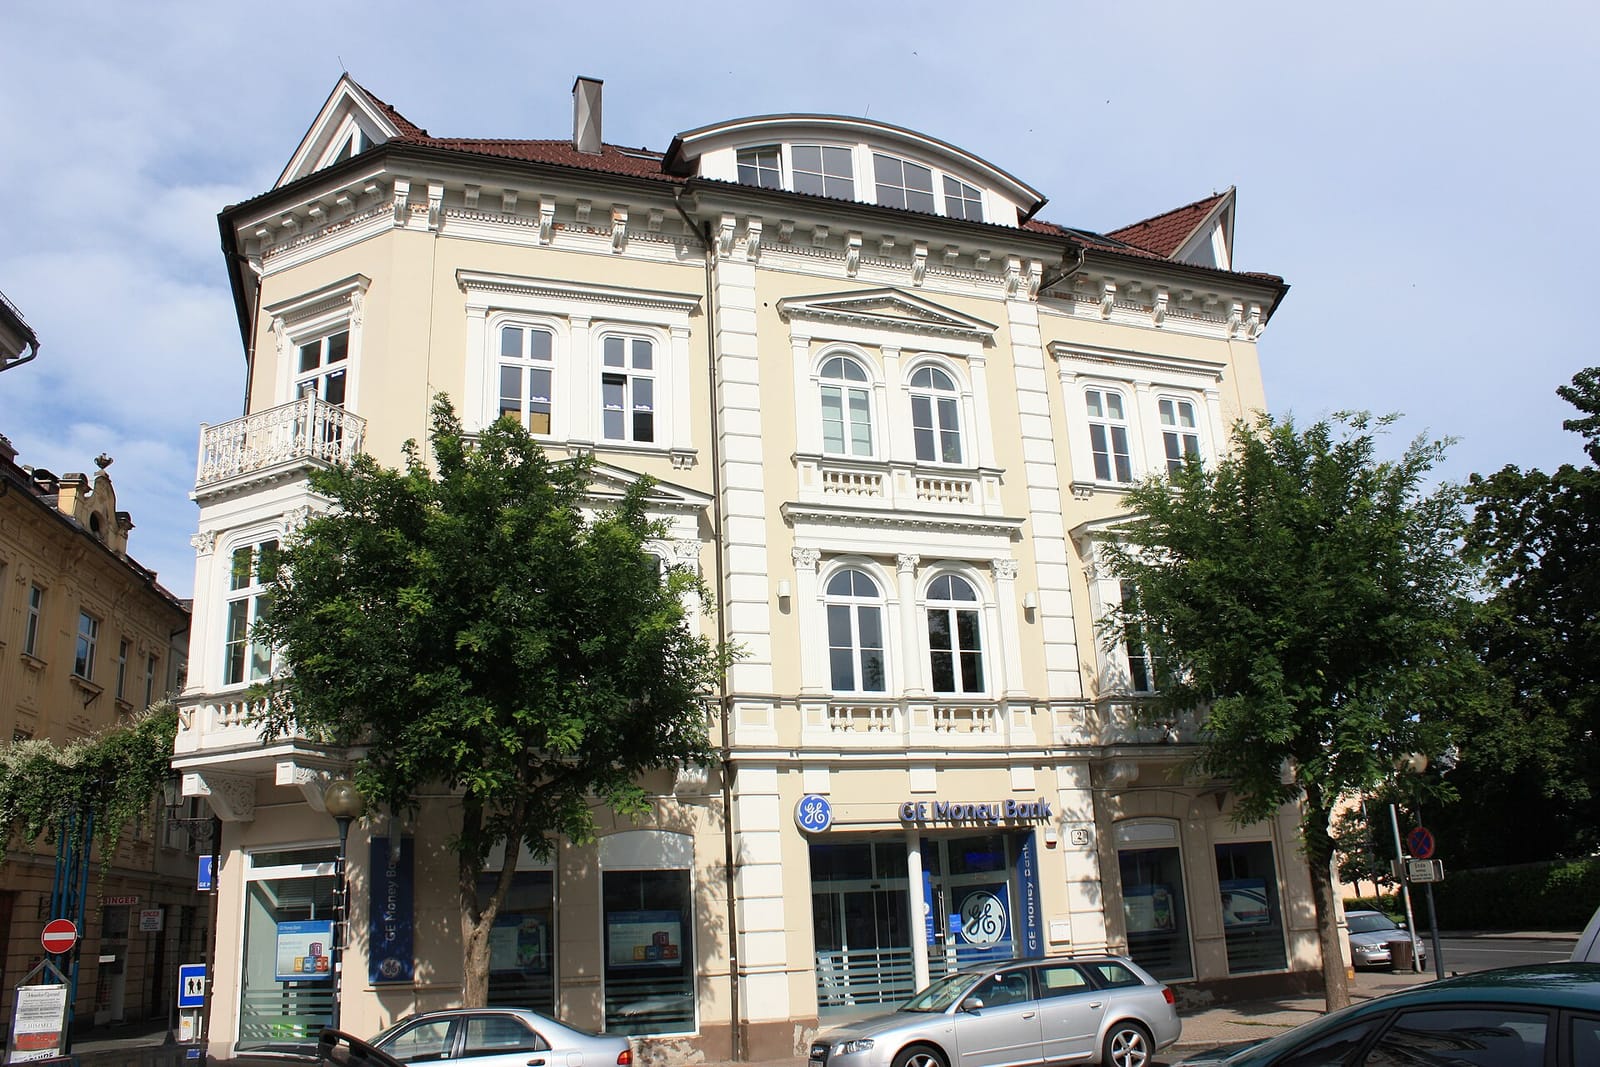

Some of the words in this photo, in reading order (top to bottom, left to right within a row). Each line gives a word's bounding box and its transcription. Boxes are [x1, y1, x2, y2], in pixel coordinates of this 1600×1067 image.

[900, 801, 929, 822] GE
[933, 800, 1001, 824] Money
[1003, 796, 1053, 819] Bank
[385, 880, 400, 921] Money
[1027, 882, 1035, 927] Money
[385, 924, 397, 942] GE
[1029, 931, 1037, 950] GE
